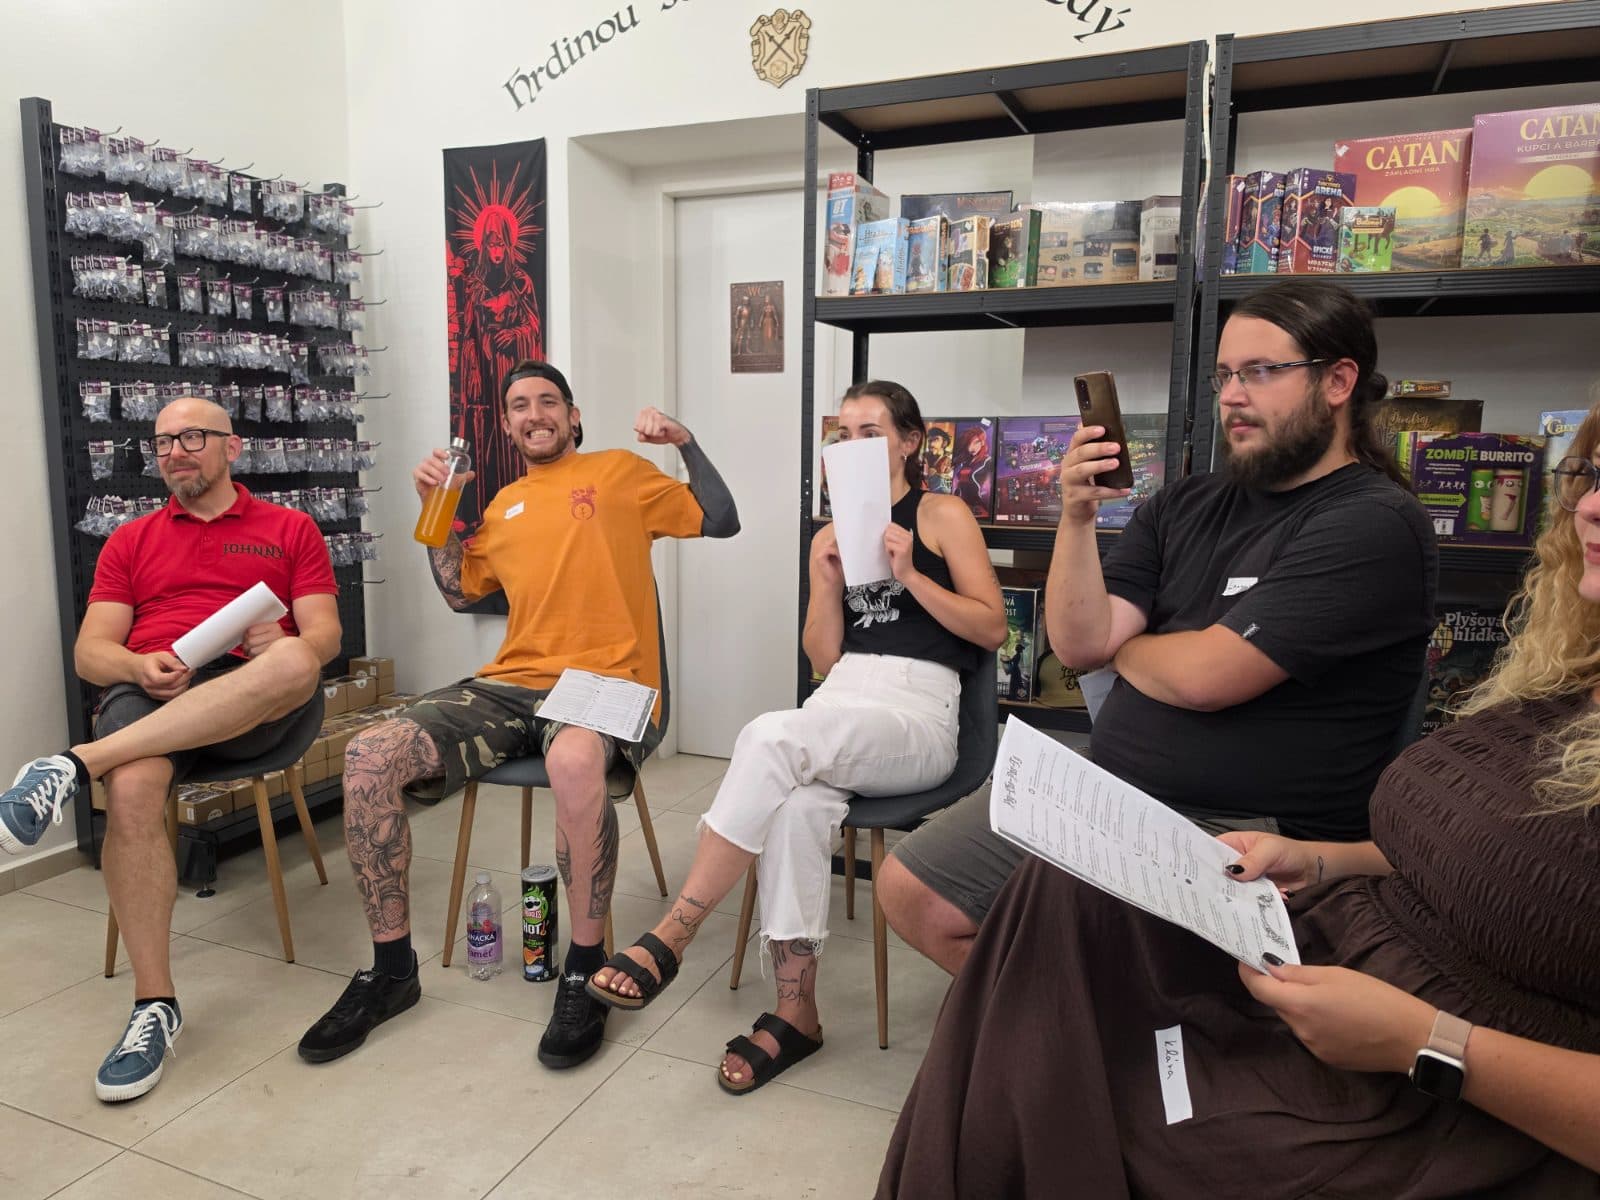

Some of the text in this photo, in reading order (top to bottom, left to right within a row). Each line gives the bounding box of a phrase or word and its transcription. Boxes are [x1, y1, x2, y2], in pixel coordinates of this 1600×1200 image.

[502, 4, 641, 112] Hrdinou
[1366, 138, 1463, 171] CATAN
[1425, 446, 1535, 463] ZOMBIE BURRITO
[223, 543, 285, 560] JOHNNY
[1453, 626, 1505, 642] hlídka
